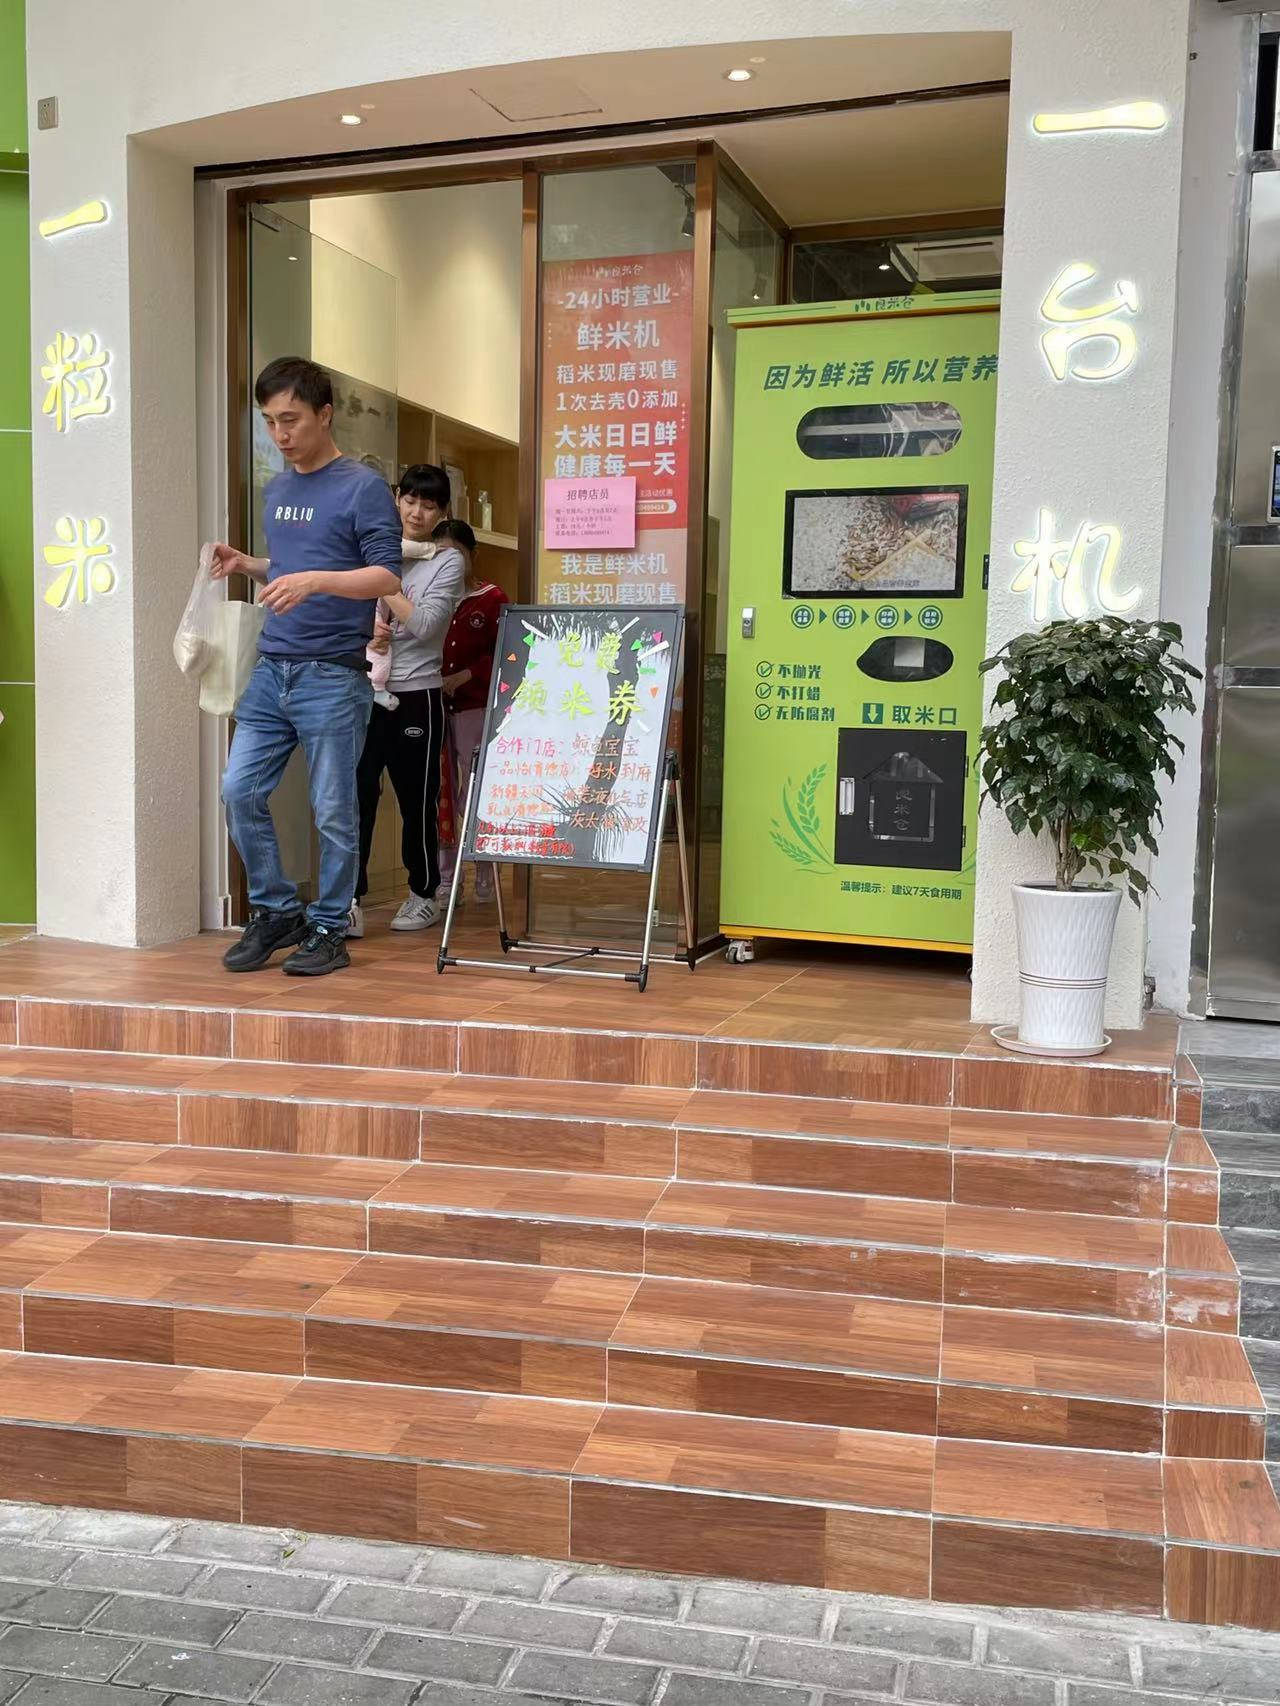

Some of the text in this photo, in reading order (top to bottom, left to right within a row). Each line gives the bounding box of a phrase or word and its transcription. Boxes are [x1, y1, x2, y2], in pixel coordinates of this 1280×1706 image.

[576, 320, 660, 351] 鲜米机
[556, 359, 677, 385] 稻米现磨现售
[763, 354, 998, 391] 因为鲜活 所以营养
[556, 388, 677, 411] 1次去壳0添加
[554, 421, 677, 448] 大米日日鲜
[554, 452, 676, 477] 健康每一天
[567, 488, 609, 501] 招聘店员
[274, 505, 314, 522] RBLIU
[561, 553, 668, 576] 我是鲜米机
[549, 582, 677, 605] 稻米现磨现售
[777, 664, 822, 679] 不抛光
[776, 685, 821, 700] 不打蜡
[775, 705, 835, 721] 无防腐剂
[892, 705, 957, 725] 取米口
